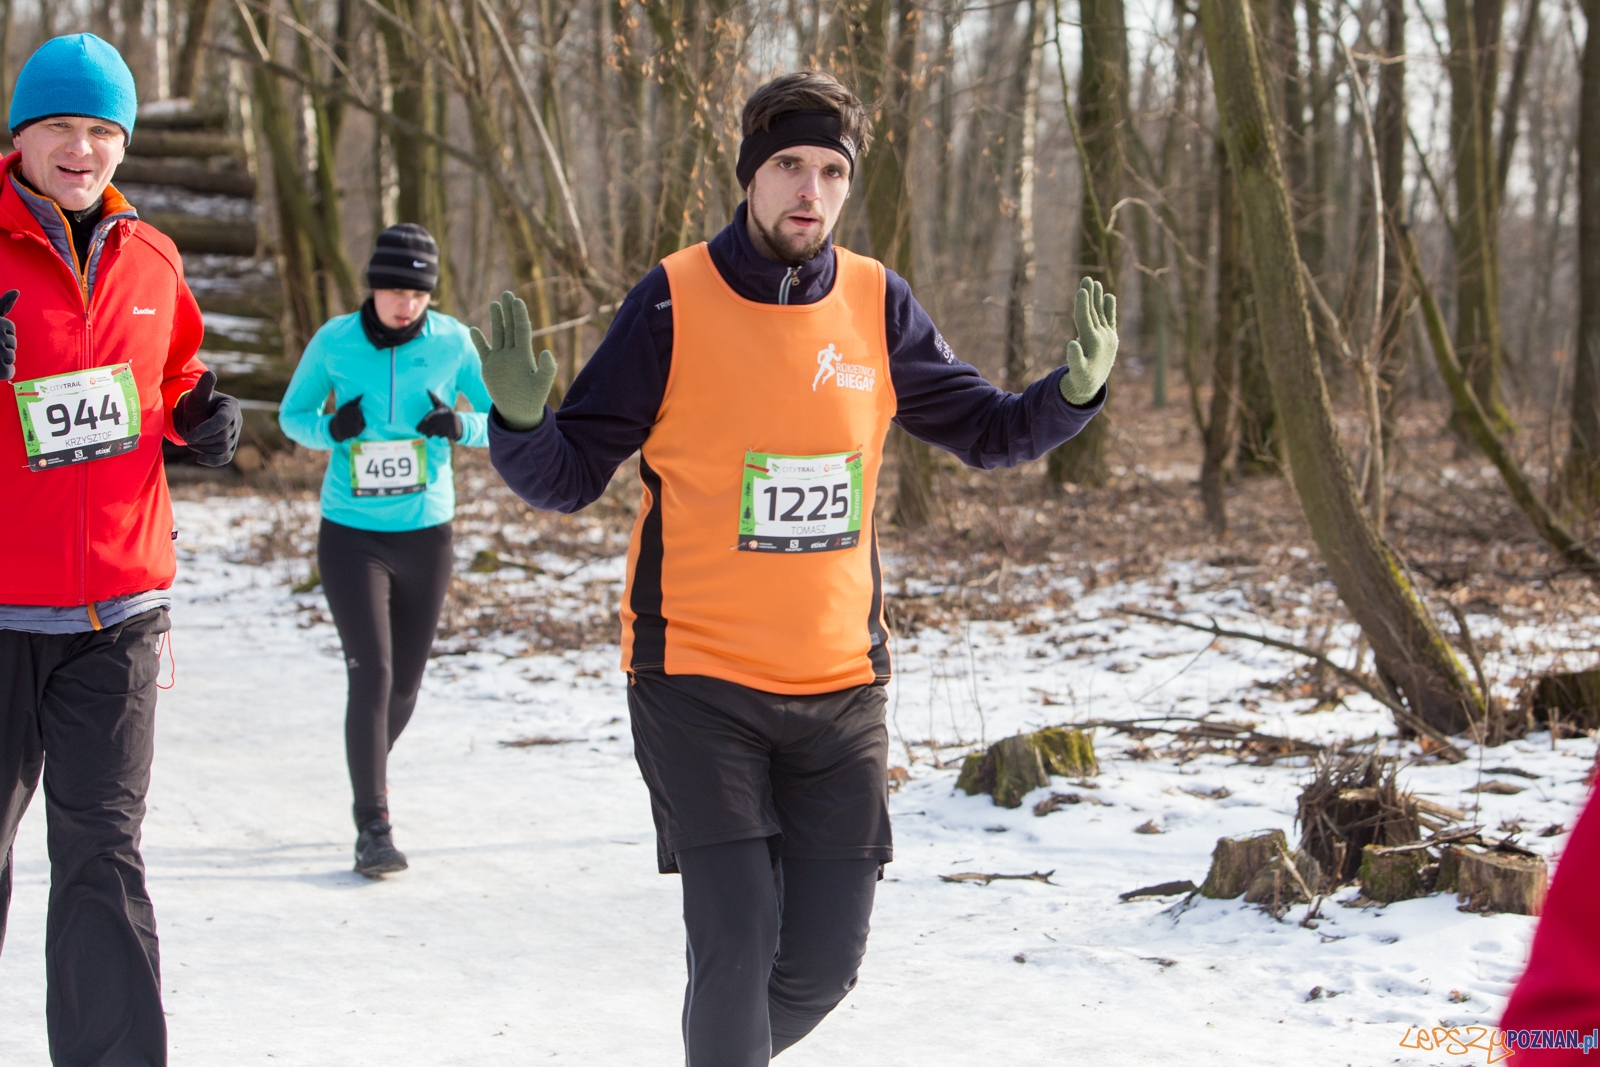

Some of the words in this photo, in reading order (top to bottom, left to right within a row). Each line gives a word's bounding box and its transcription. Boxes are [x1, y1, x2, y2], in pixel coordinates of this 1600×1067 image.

[836, 362, 876, 378] ROKIETNICA
[46, 394, 122, 438] 944
[65, 430, 112, 448] KRZYSZTOF
[365, 457, 412, 478] 469
[763, 482, 848, 522] 1225
[791, 524, 827, 535] TOMASZ
